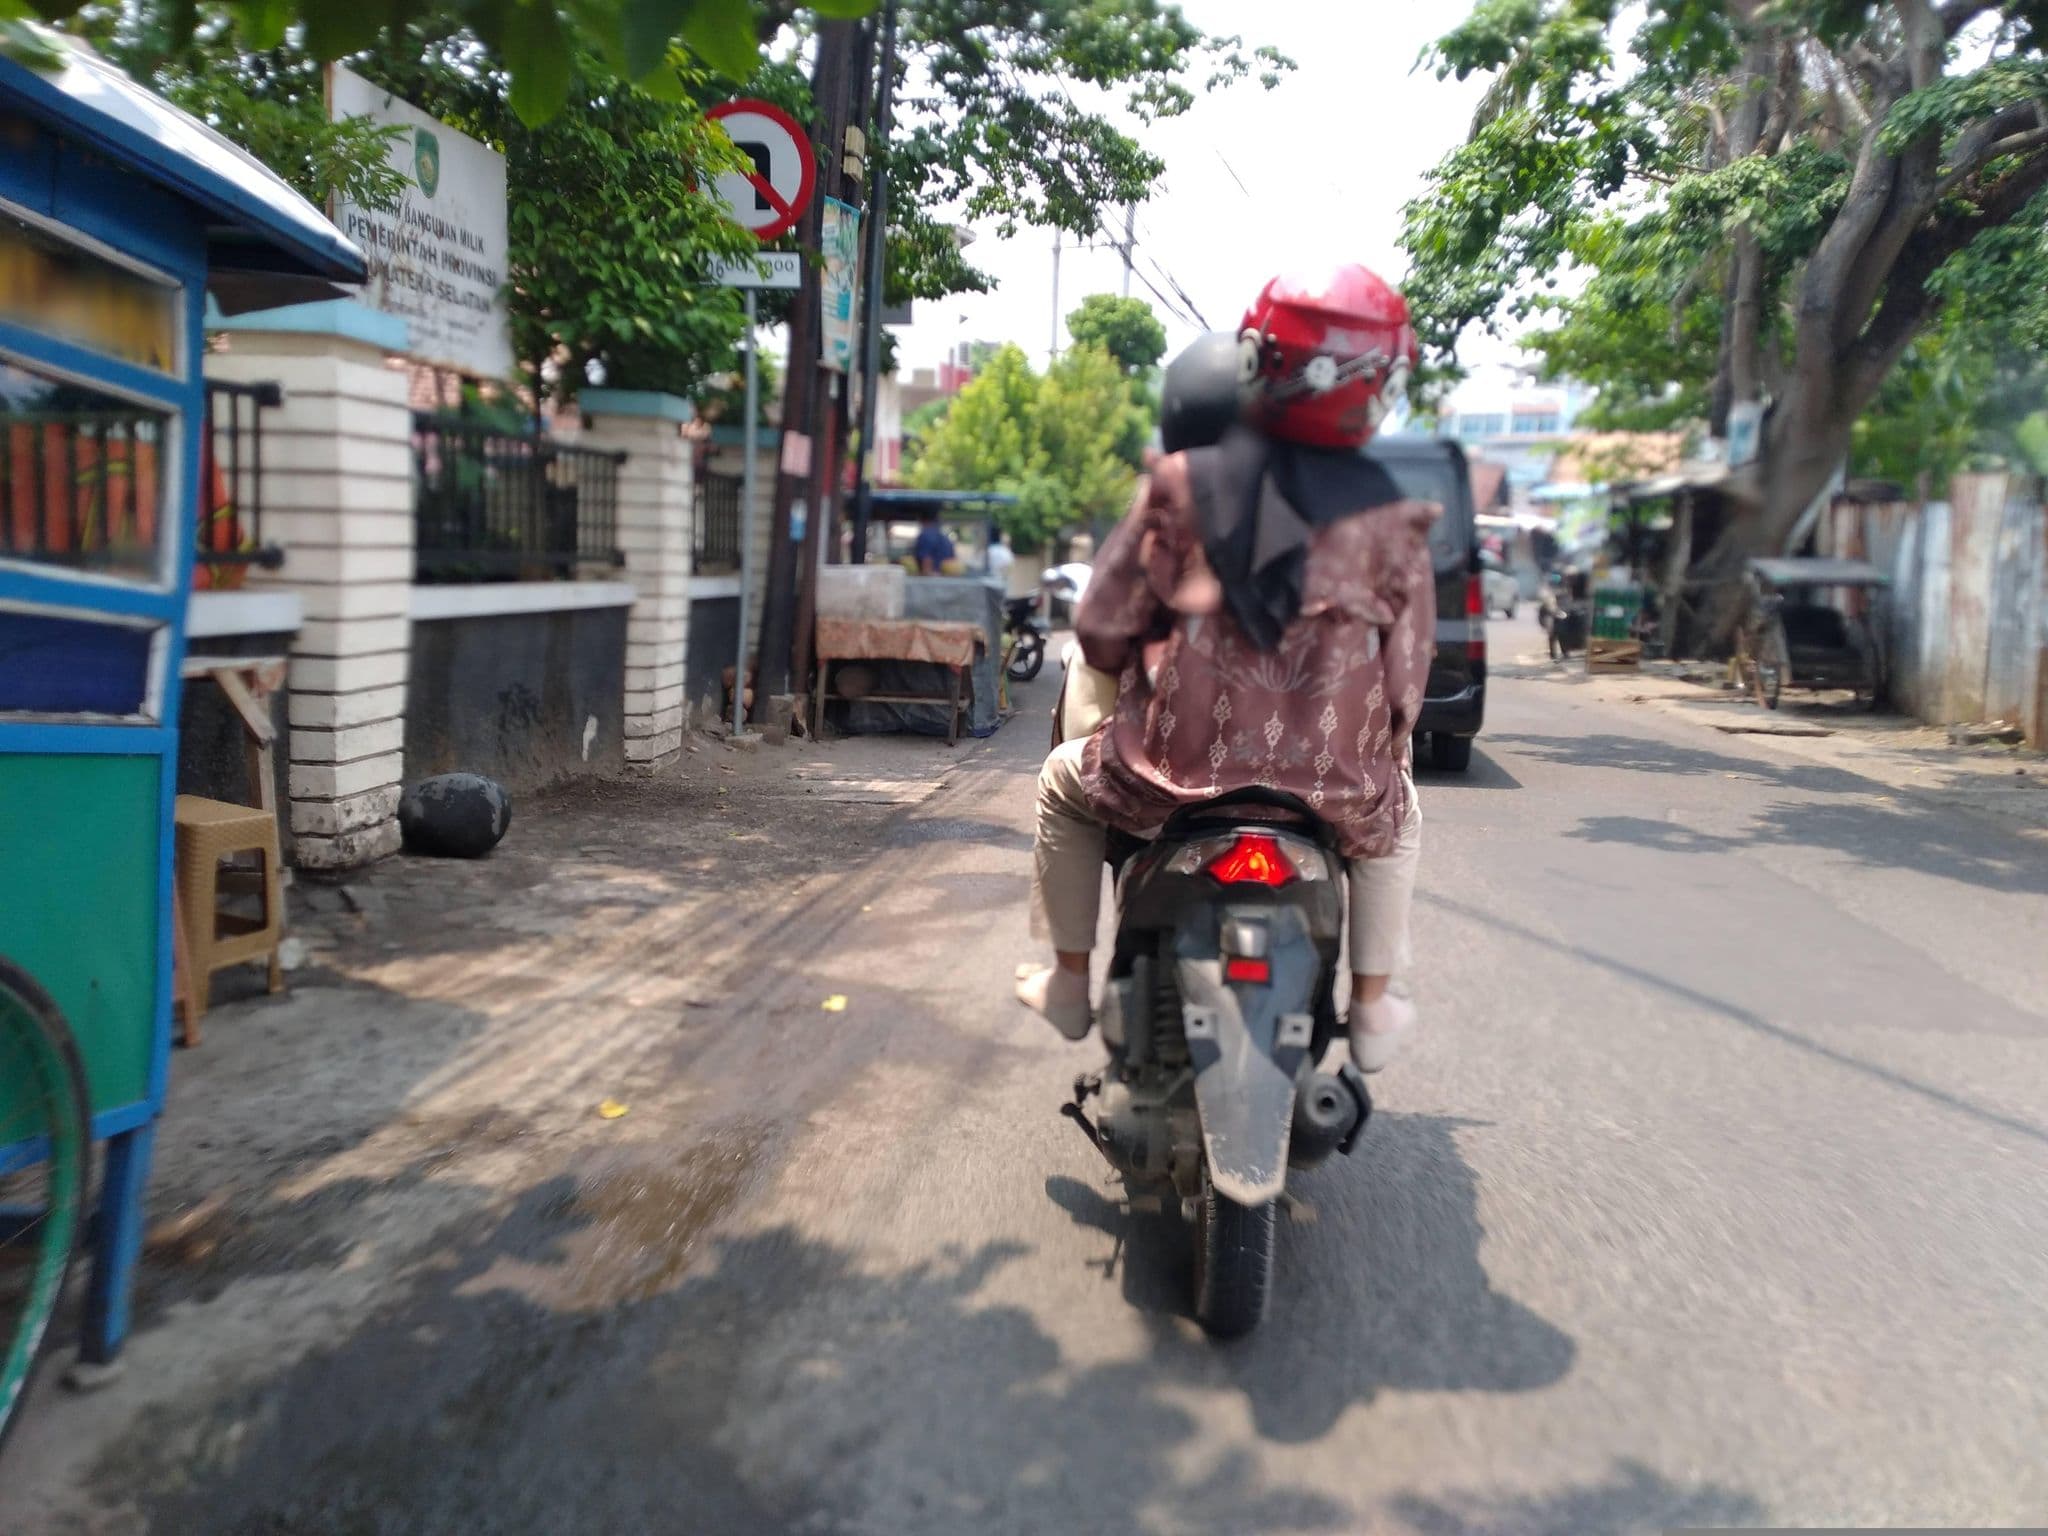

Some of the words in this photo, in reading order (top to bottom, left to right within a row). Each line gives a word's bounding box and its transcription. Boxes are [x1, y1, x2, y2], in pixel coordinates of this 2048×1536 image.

[348, 213, 437, 266] PEMERINTAH
[441, 251, 497, 287] PROVINSI
[404, 206, 457, 243] BANGUNAN
[459, 227, 484, 253] MILIK
